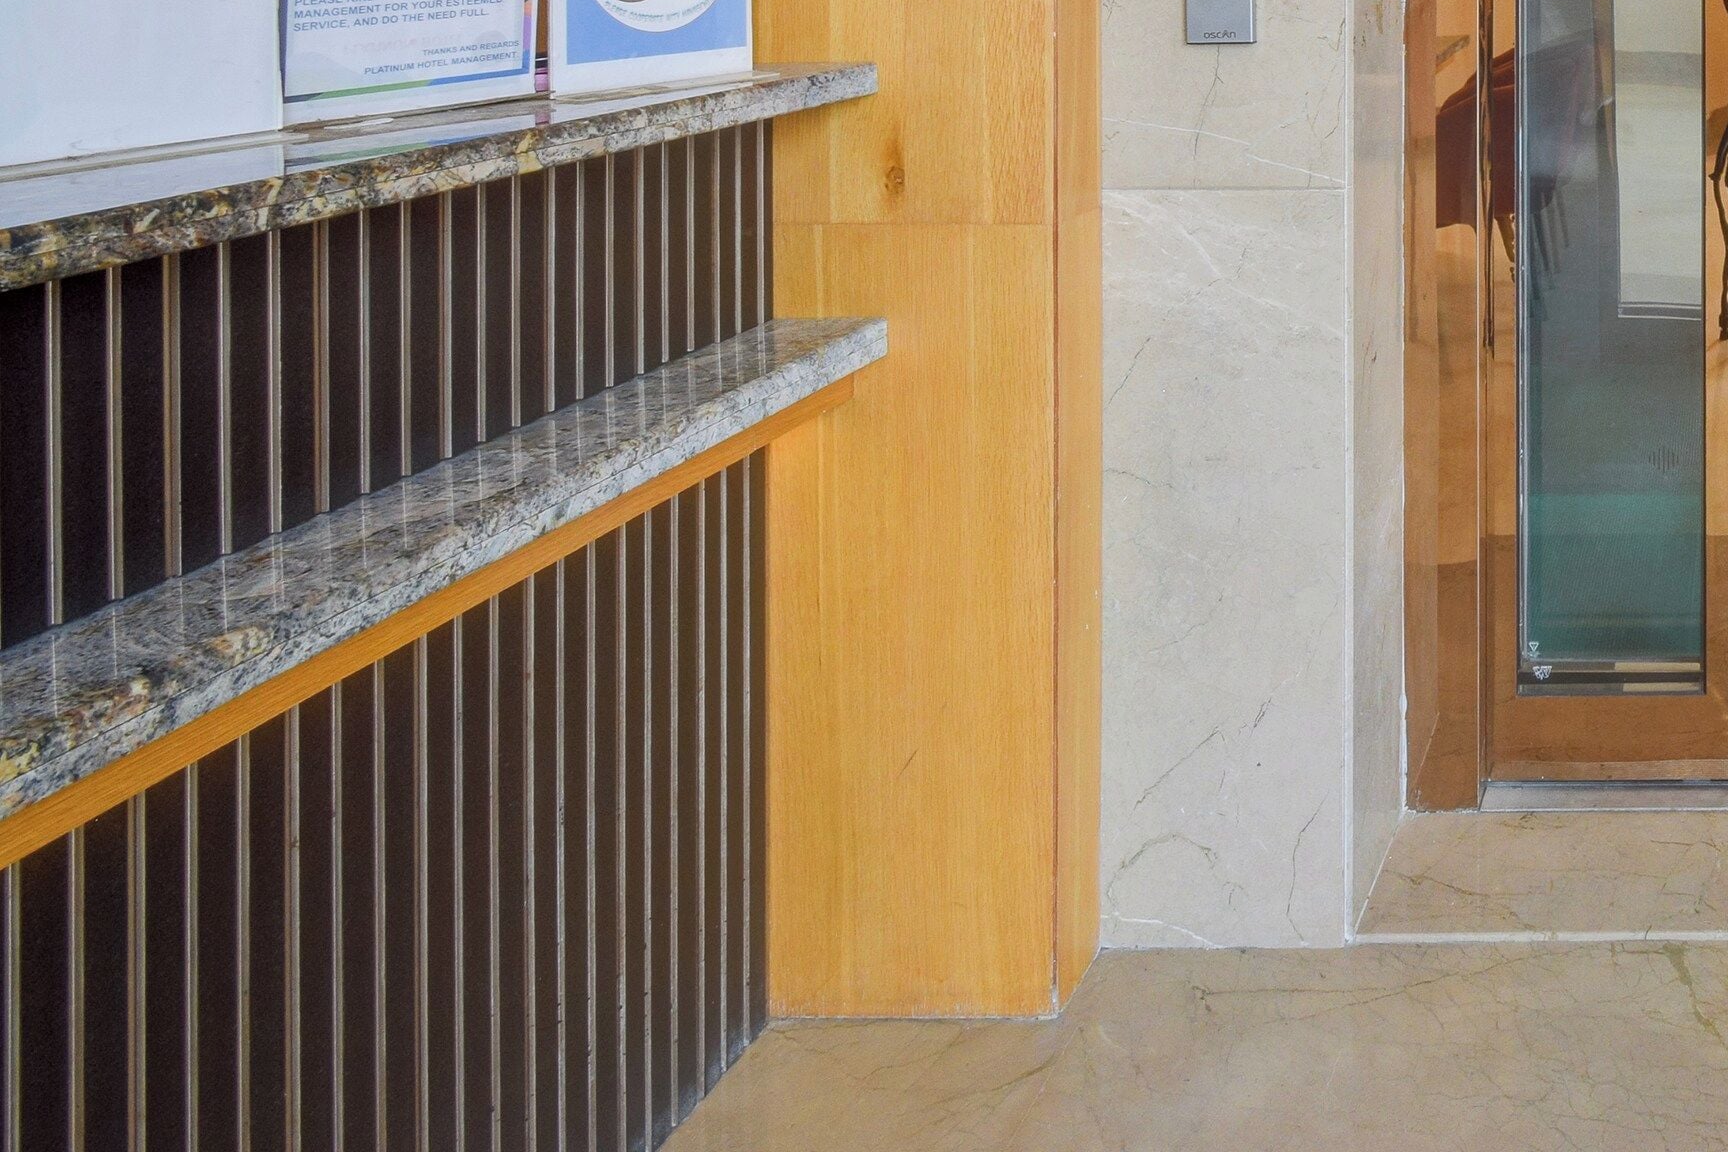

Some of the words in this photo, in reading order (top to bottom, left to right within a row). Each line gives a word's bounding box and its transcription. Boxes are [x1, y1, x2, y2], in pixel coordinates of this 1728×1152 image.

[294, 4, 381, 19] MANAGEMENT
[385, 3, 408, 11] FOR
[412, 0, 443, 10] YOUR
[293, 19, 350, 32] SERVICE,
[354, 17, 378, 26] AND
[382, 15, 398, 24] DO
[402, 13, 424, 22] THE
[428, 11, 457, 20] NEED
[460, 8, 489, 17] FULL.
[423, 48, 458, 56] THANKS
[460, 44, 477, 53] AND
[480, 40, 519, 50] REGARDS
[364, 62, 415, 75] PLATINUM
[417, 59, 448, 69] HOTEL
